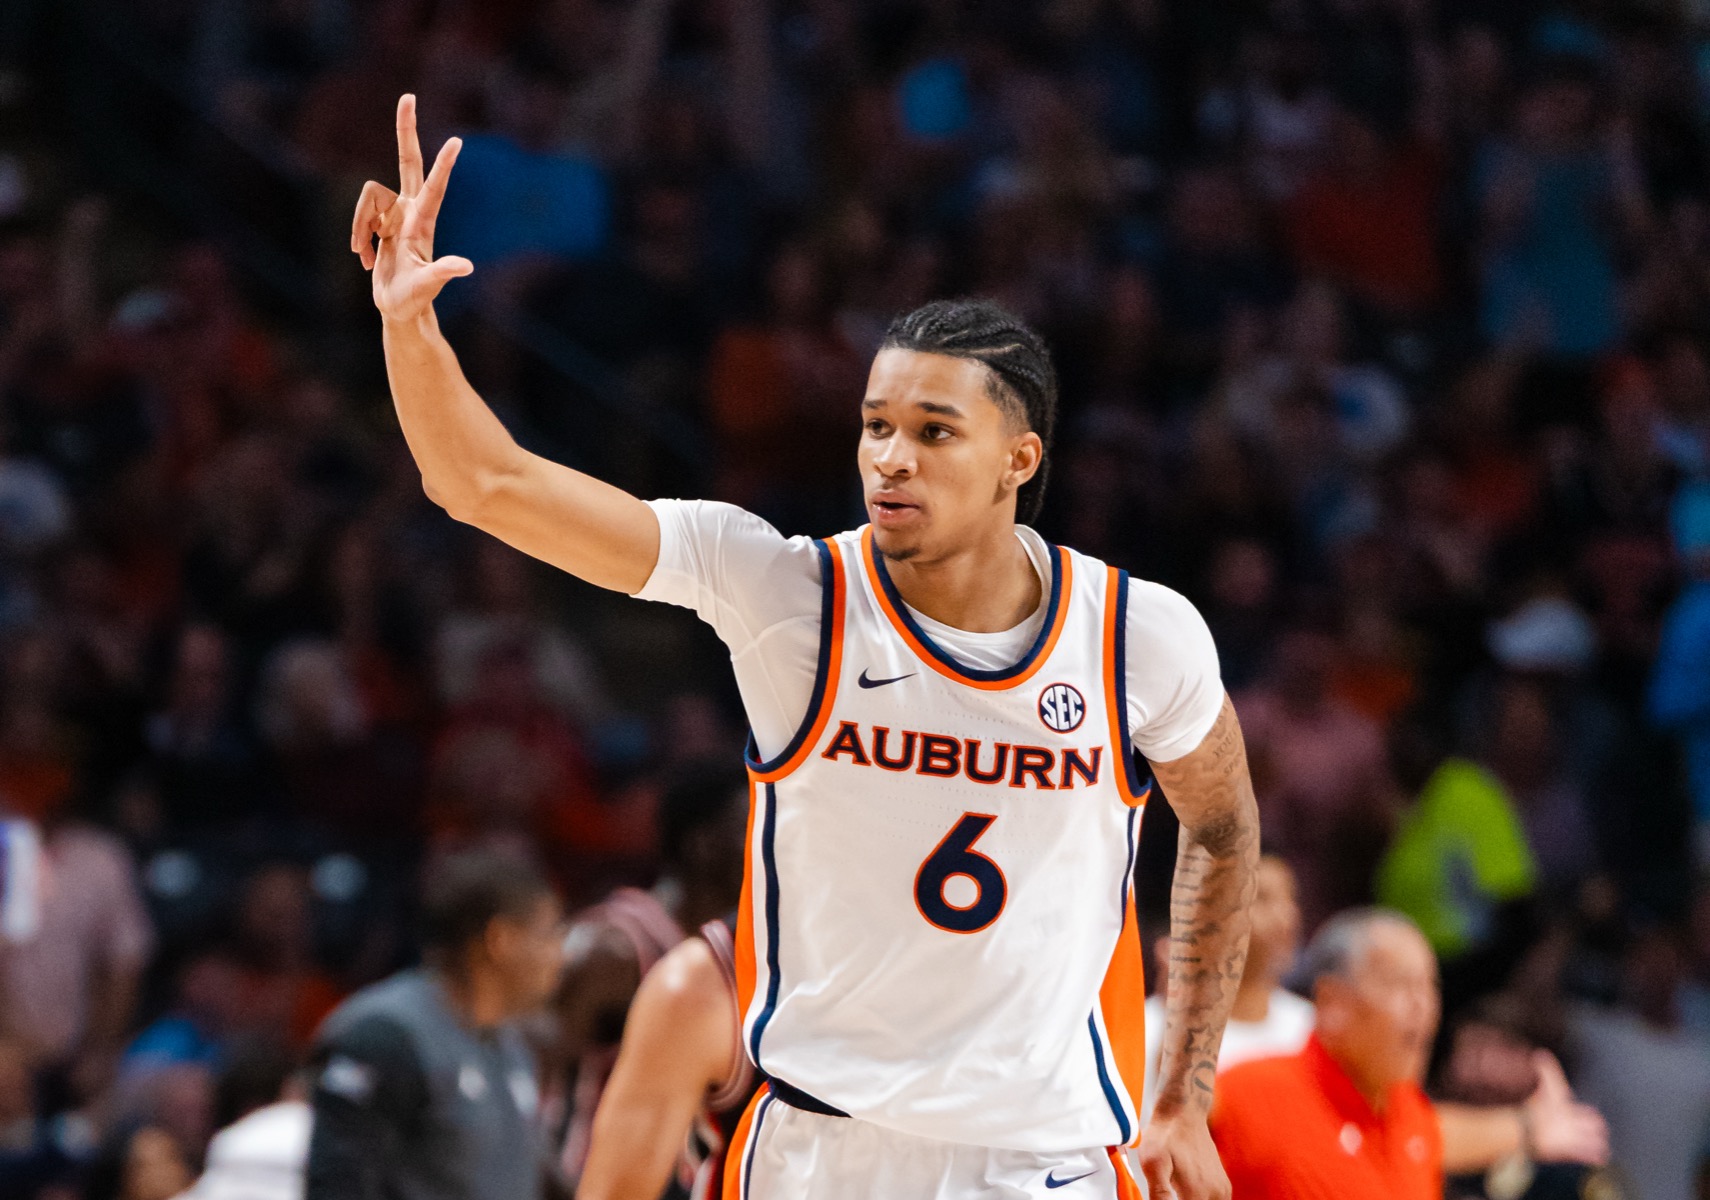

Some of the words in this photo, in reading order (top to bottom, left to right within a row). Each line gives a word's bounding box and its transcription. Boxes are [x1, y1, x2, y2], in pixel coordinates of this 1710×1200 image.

[1040, 686, 1083, 731] SEC
[821, 720, 1104, 790] AUBURN
[913, 811, 1008, 935] 6
